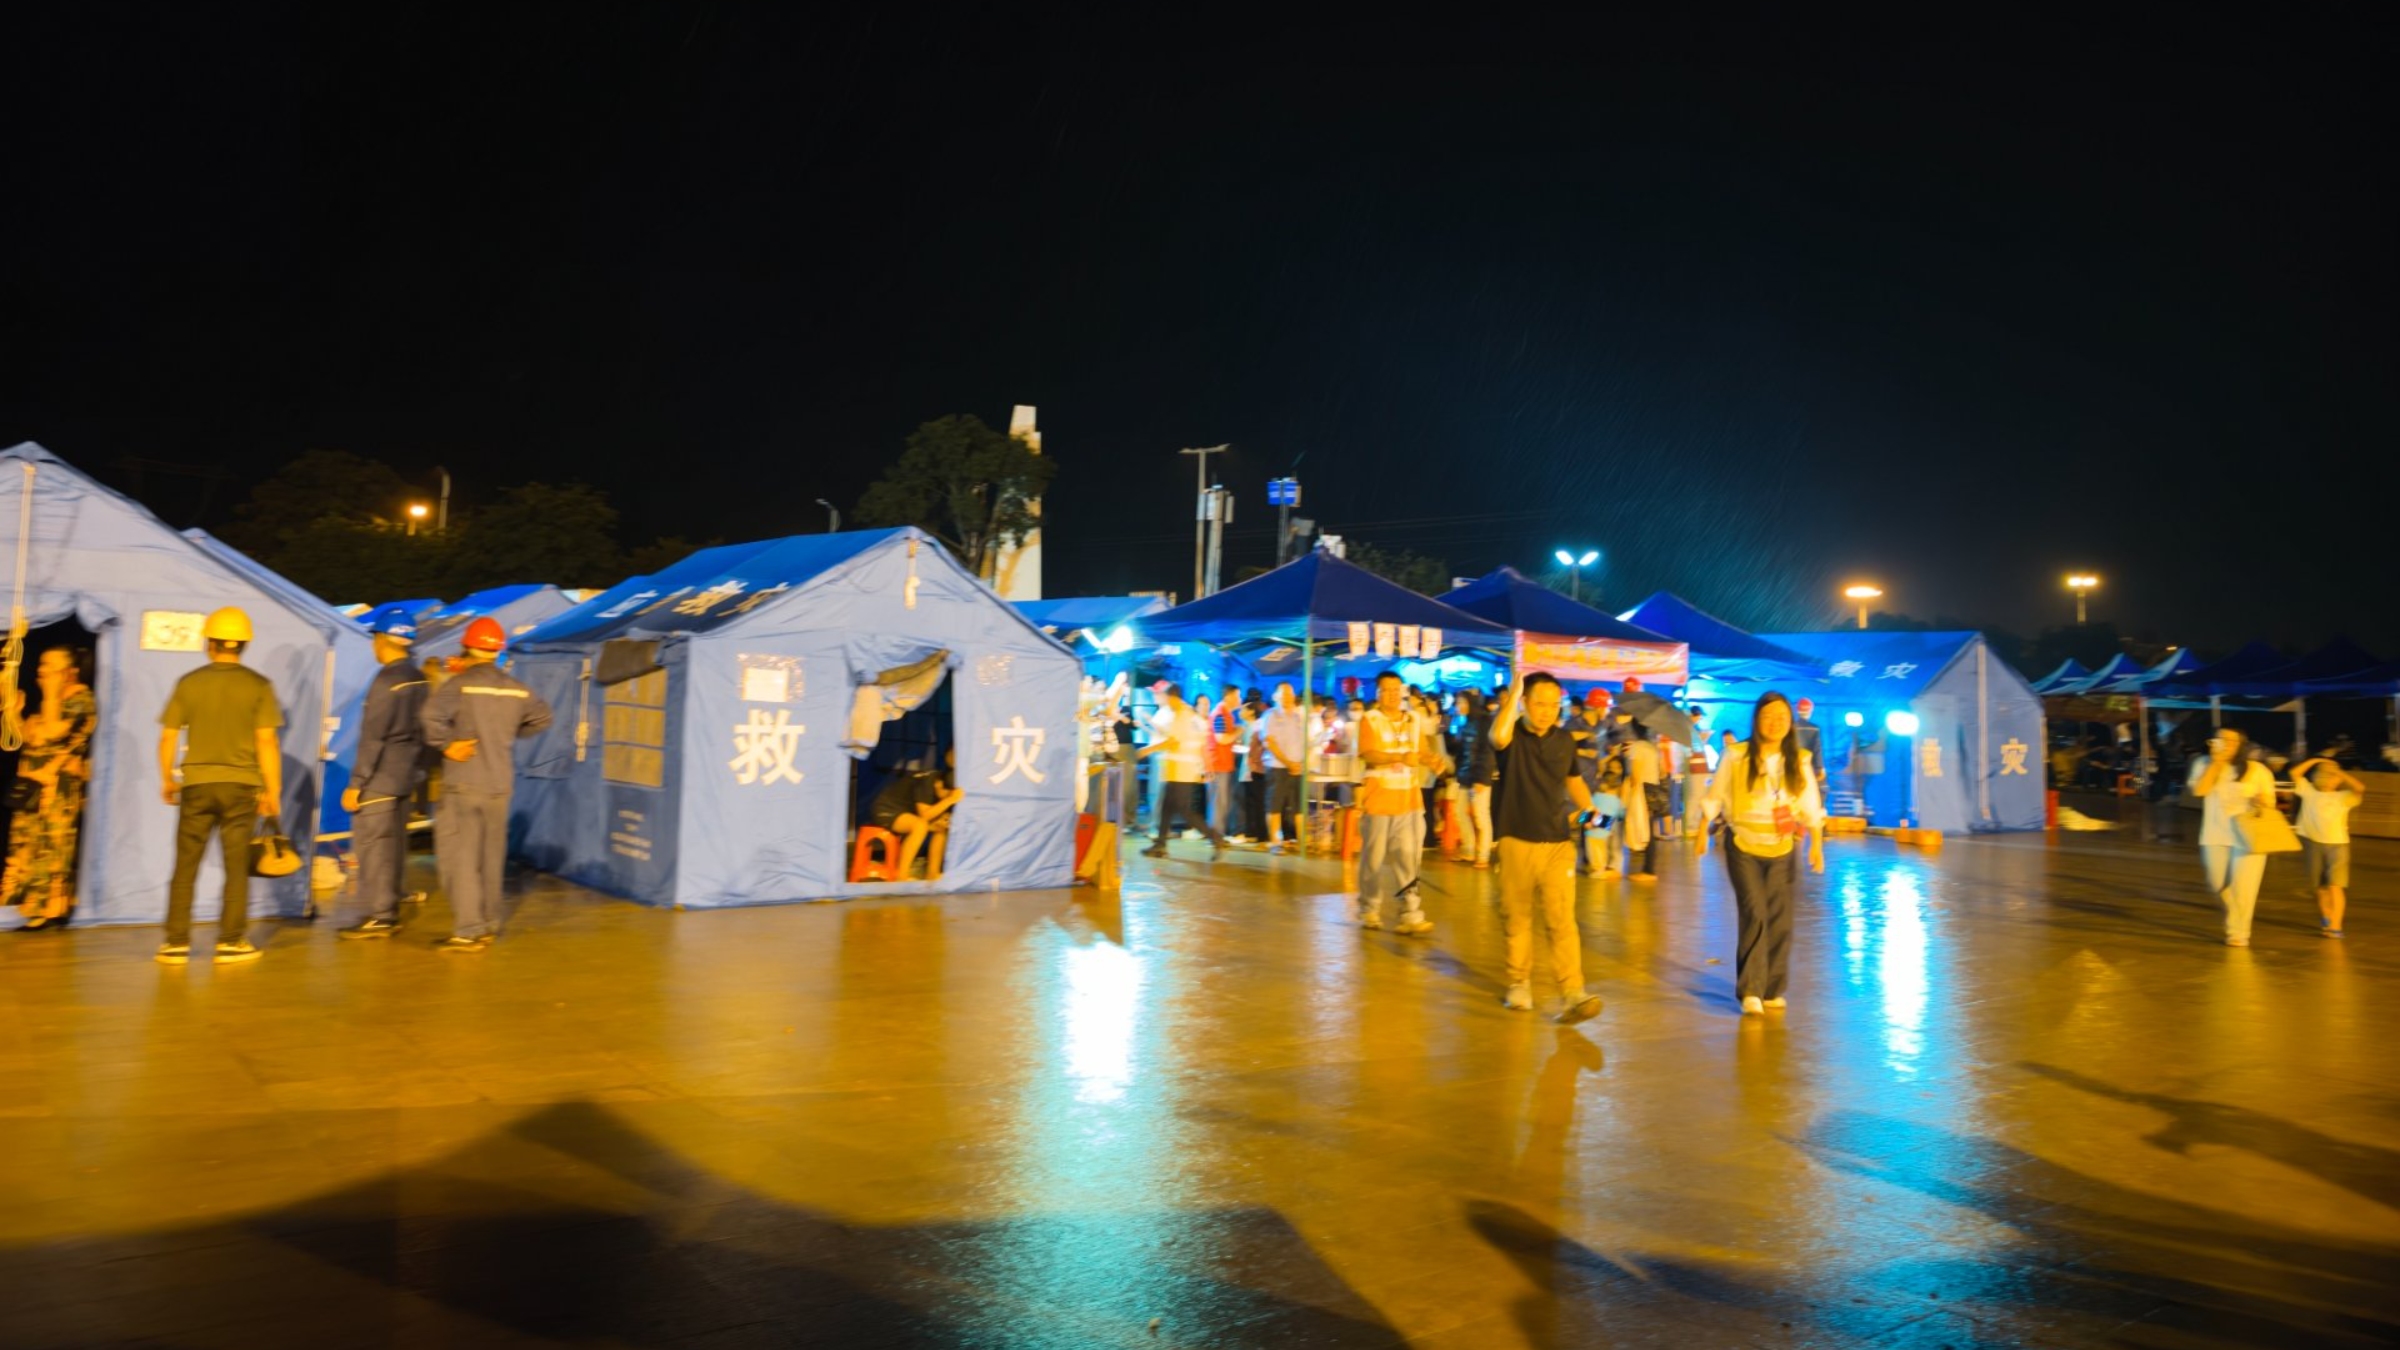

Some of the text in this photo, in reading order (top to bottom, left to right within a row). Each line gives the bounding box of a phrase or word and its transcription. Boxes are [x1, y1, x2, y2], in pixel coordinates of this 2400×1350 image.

[729, 708, 1046, 786] 救 灾
[2000, 738, 2028, 776] 灾
